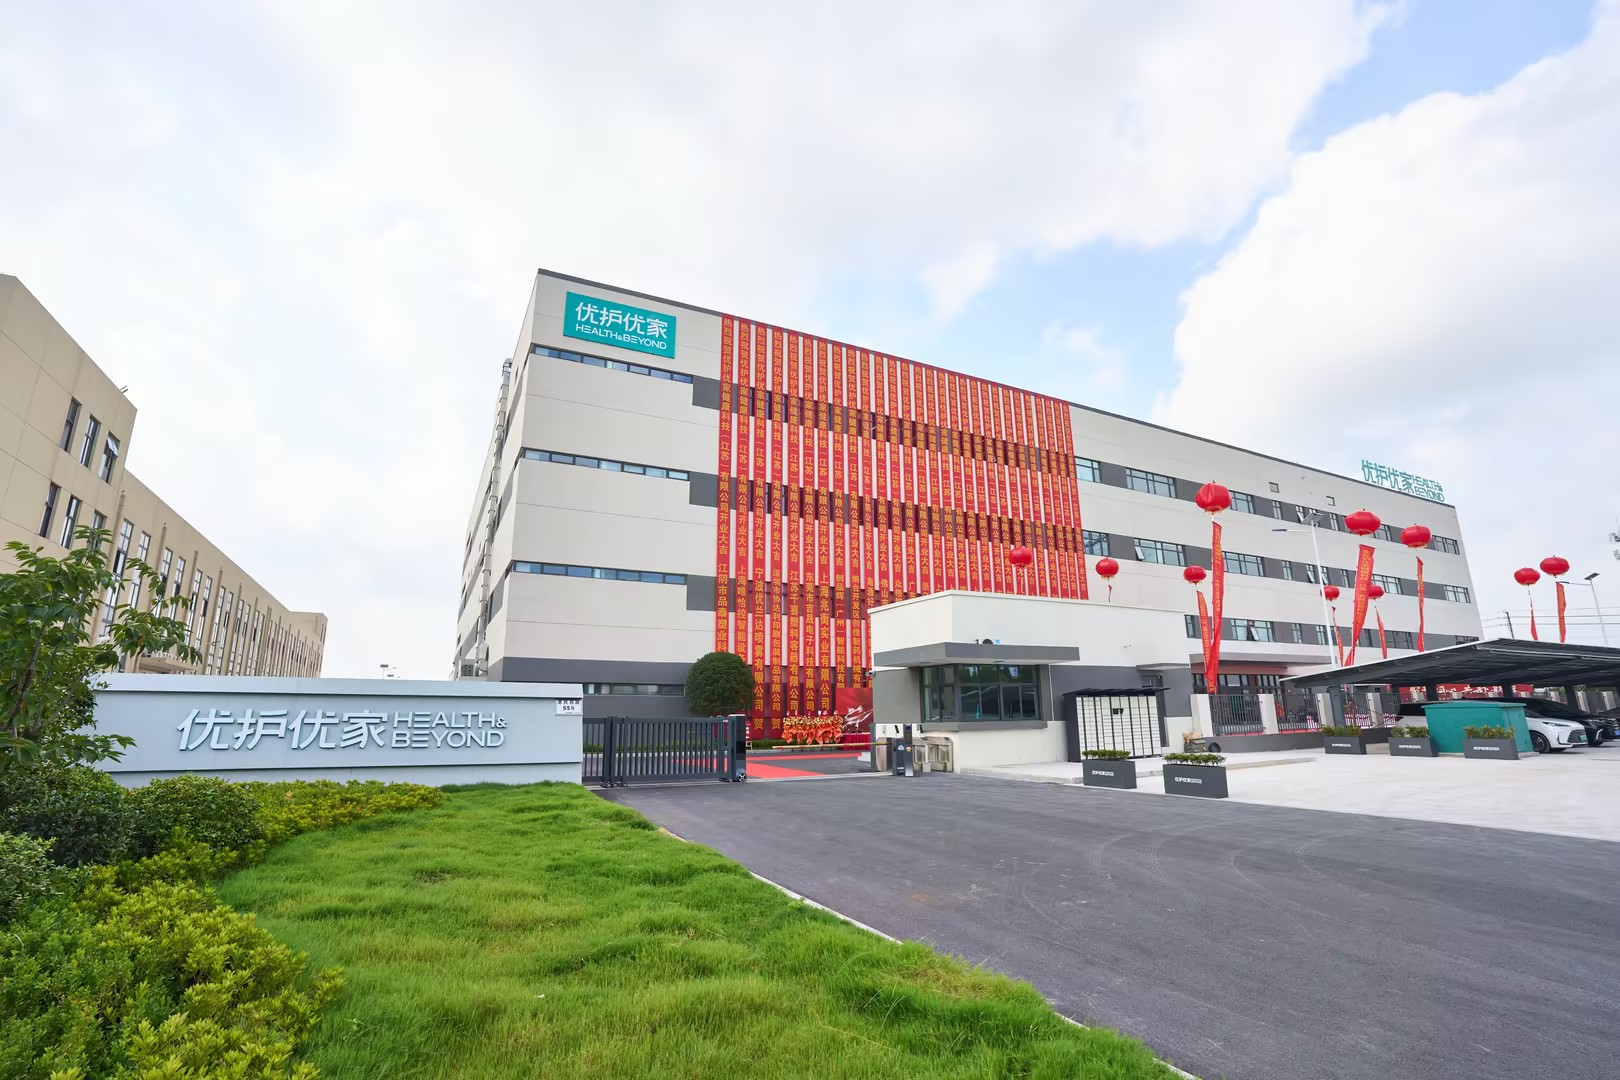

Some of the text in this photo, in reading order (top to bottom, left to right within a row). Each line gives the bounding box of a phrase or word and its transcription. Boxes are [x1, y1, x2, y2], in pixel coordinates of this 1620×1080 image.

[575, 302, 668, 339] 优护优家
[575, 323, 667, 350] HEALTH&BEYOND
[1361, 459, 1414, 494] 优护优家
[1415, 486, 1445, 502] BEYOND
[392, 711, 508, 729] HEALTH&
[753, 718, 764, 730] 贺
[771, 718, 781, 730] 贺
[176, 708, 388, 752] 优护优家
[391, 730, 505, 748] BEYOND
